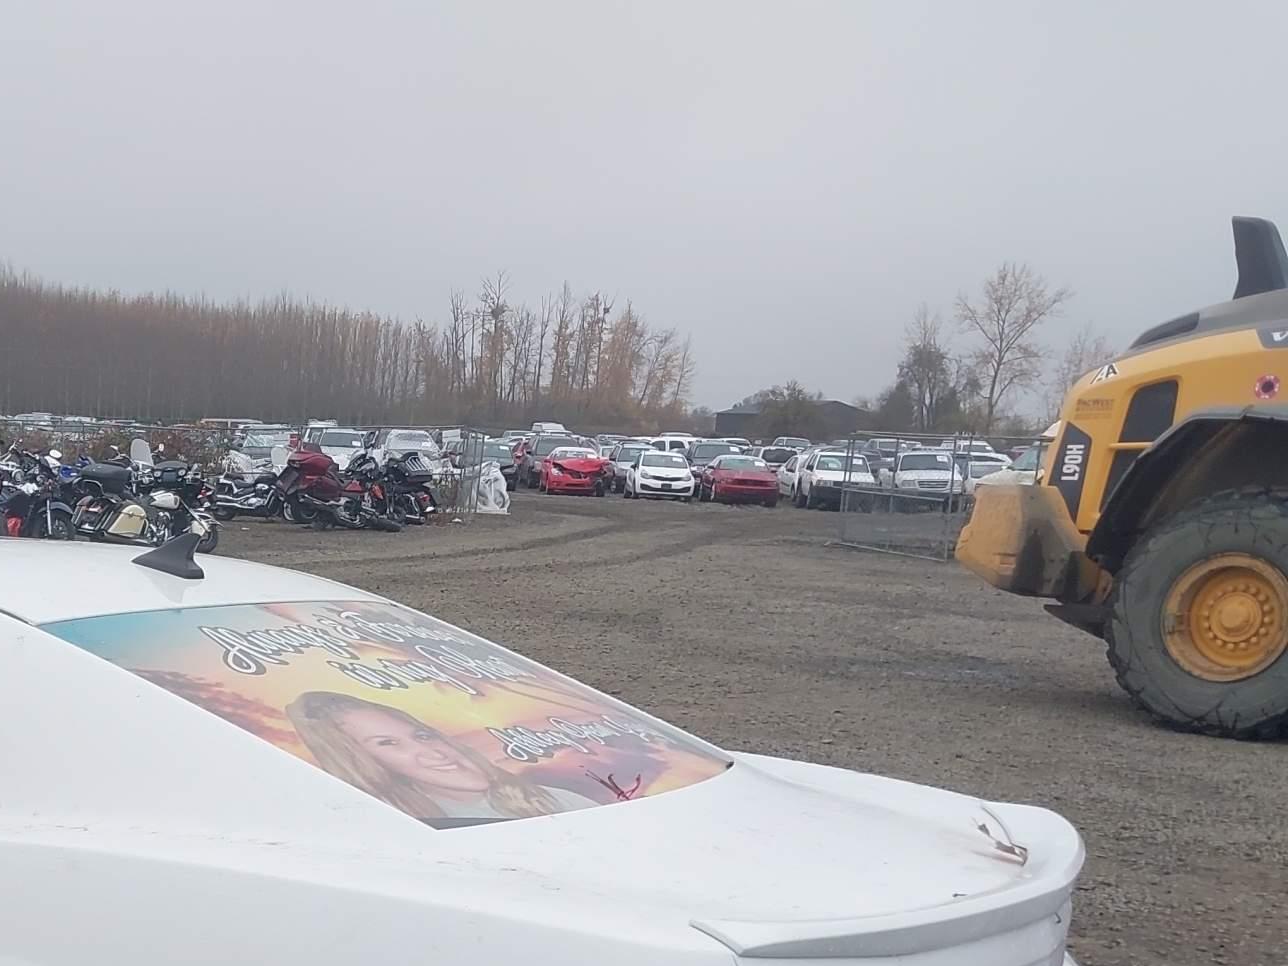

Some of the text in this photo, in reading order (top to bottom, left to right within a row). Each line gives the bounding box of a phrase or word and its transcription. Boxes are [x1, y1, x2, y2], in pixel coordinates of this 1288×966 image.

[1061, 444, 1085, 481] L90H
[198, 625, 358, 675] Always
[327, 659, 409, 690] in
[377, 657, 479, 697] my
[486, 725, 592, 763] Ashley
